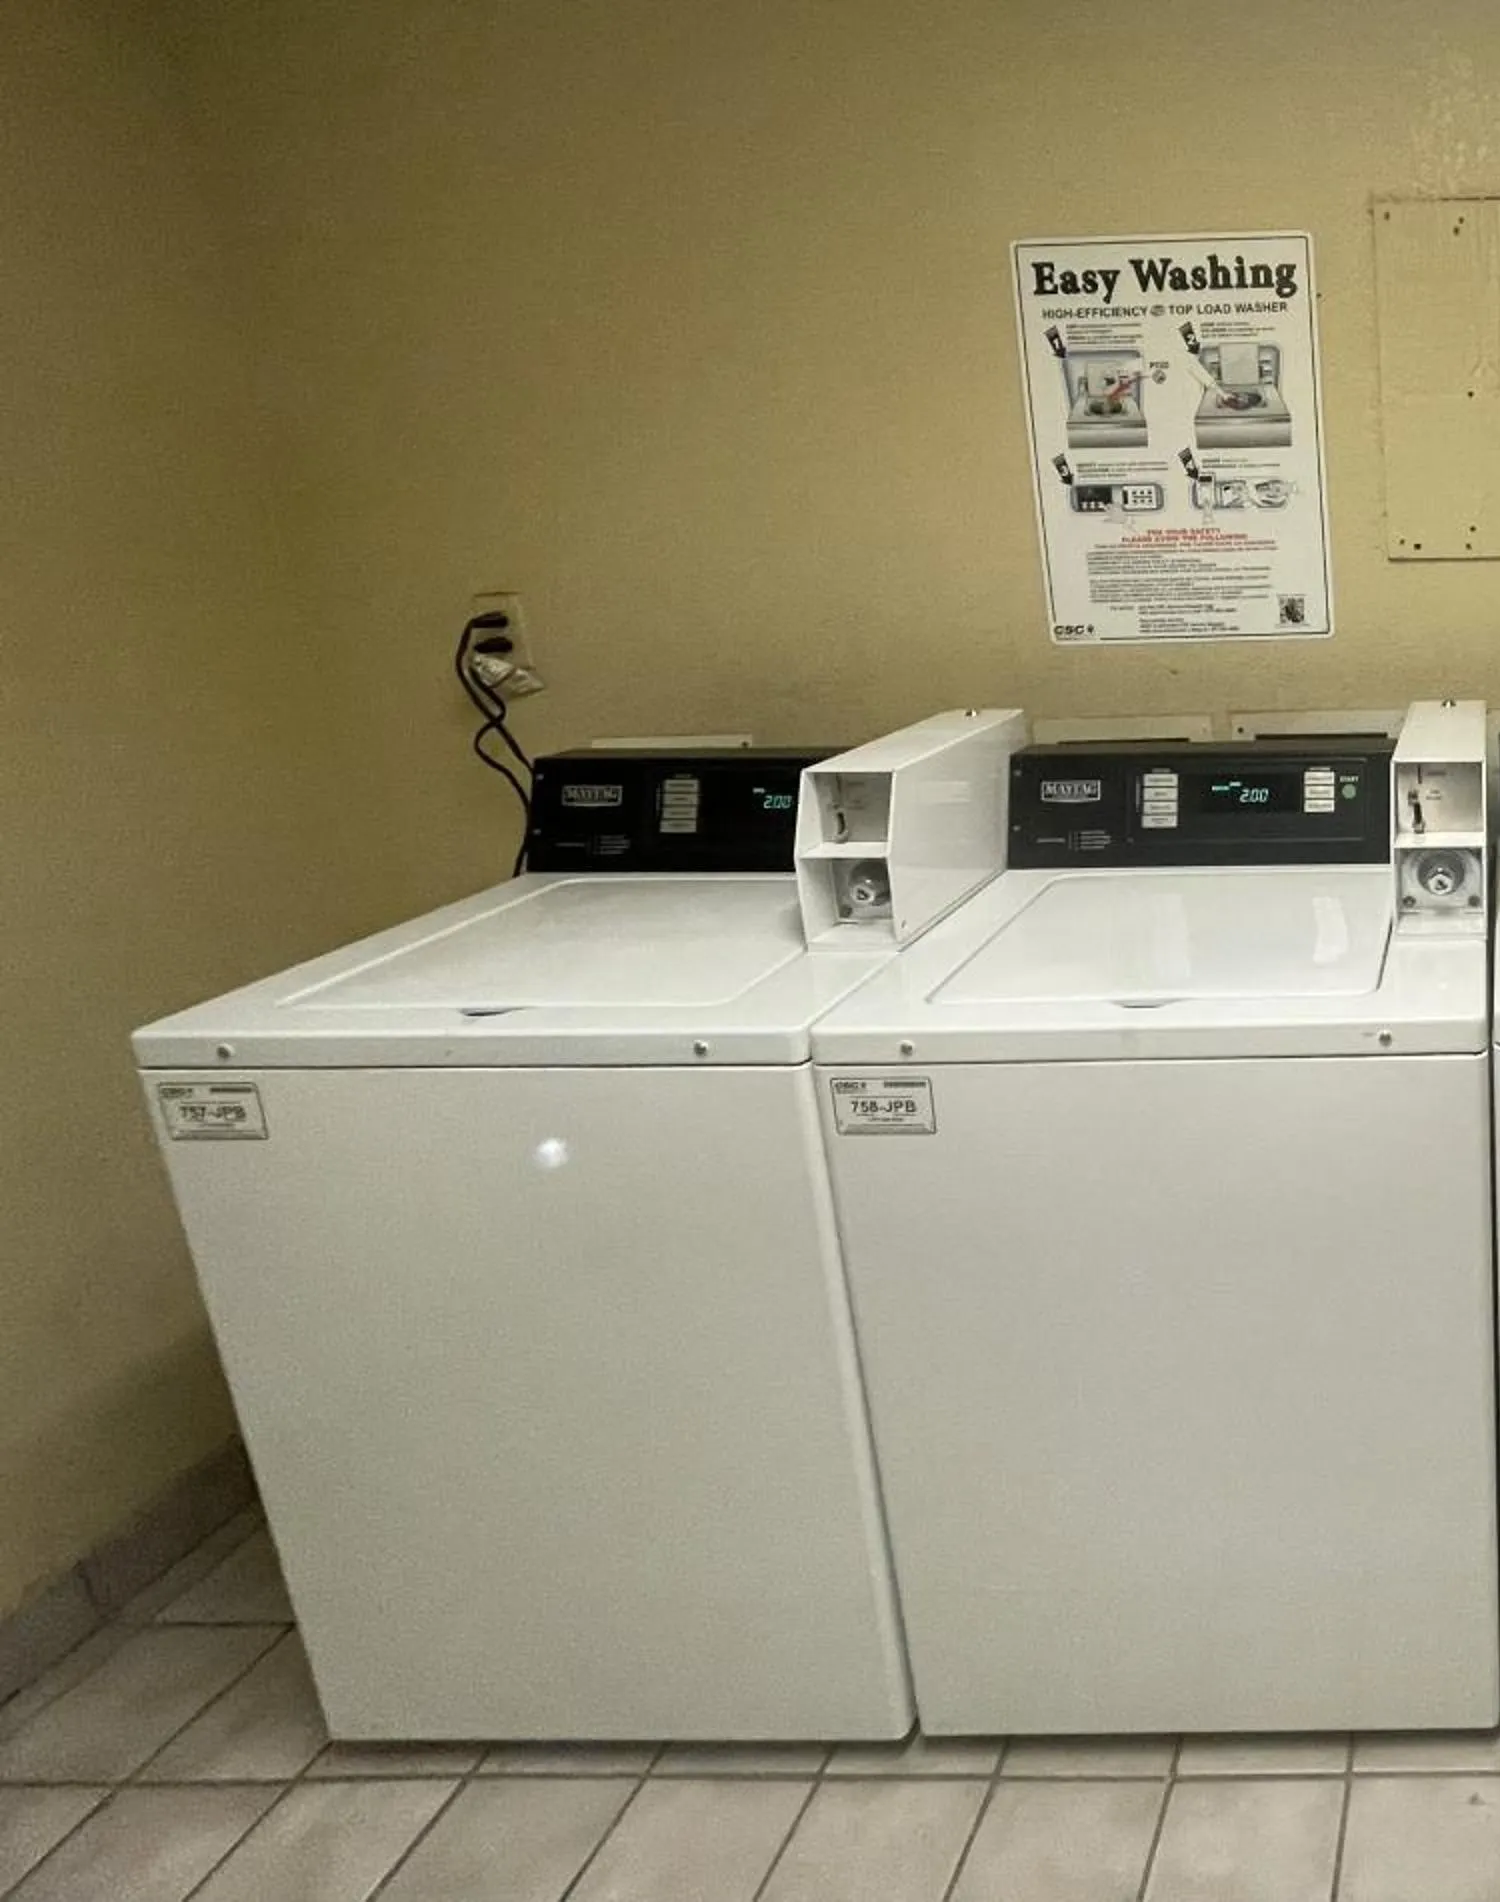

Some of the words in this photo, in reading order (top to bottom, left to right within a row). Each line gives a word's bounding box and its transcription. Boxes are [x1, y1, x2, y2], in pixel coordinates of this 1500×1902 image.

[1031, 261, 1121, 304] Easy
[1129, 253, 1298, 299] Washing
[1042, 305, 1148, 319] HIGH-EFFICIENCY
[1168, 304, 1193, 315] TOP
[1197, 303, 1231, 314] LOAD
[1235, 301, 1288, 313] WASHER
[1053, 624, 1085, 636] CSC
[1044, 783, 1097, 798] MAYTAG
[851, 1099, 918, 1113] 758-JPB
